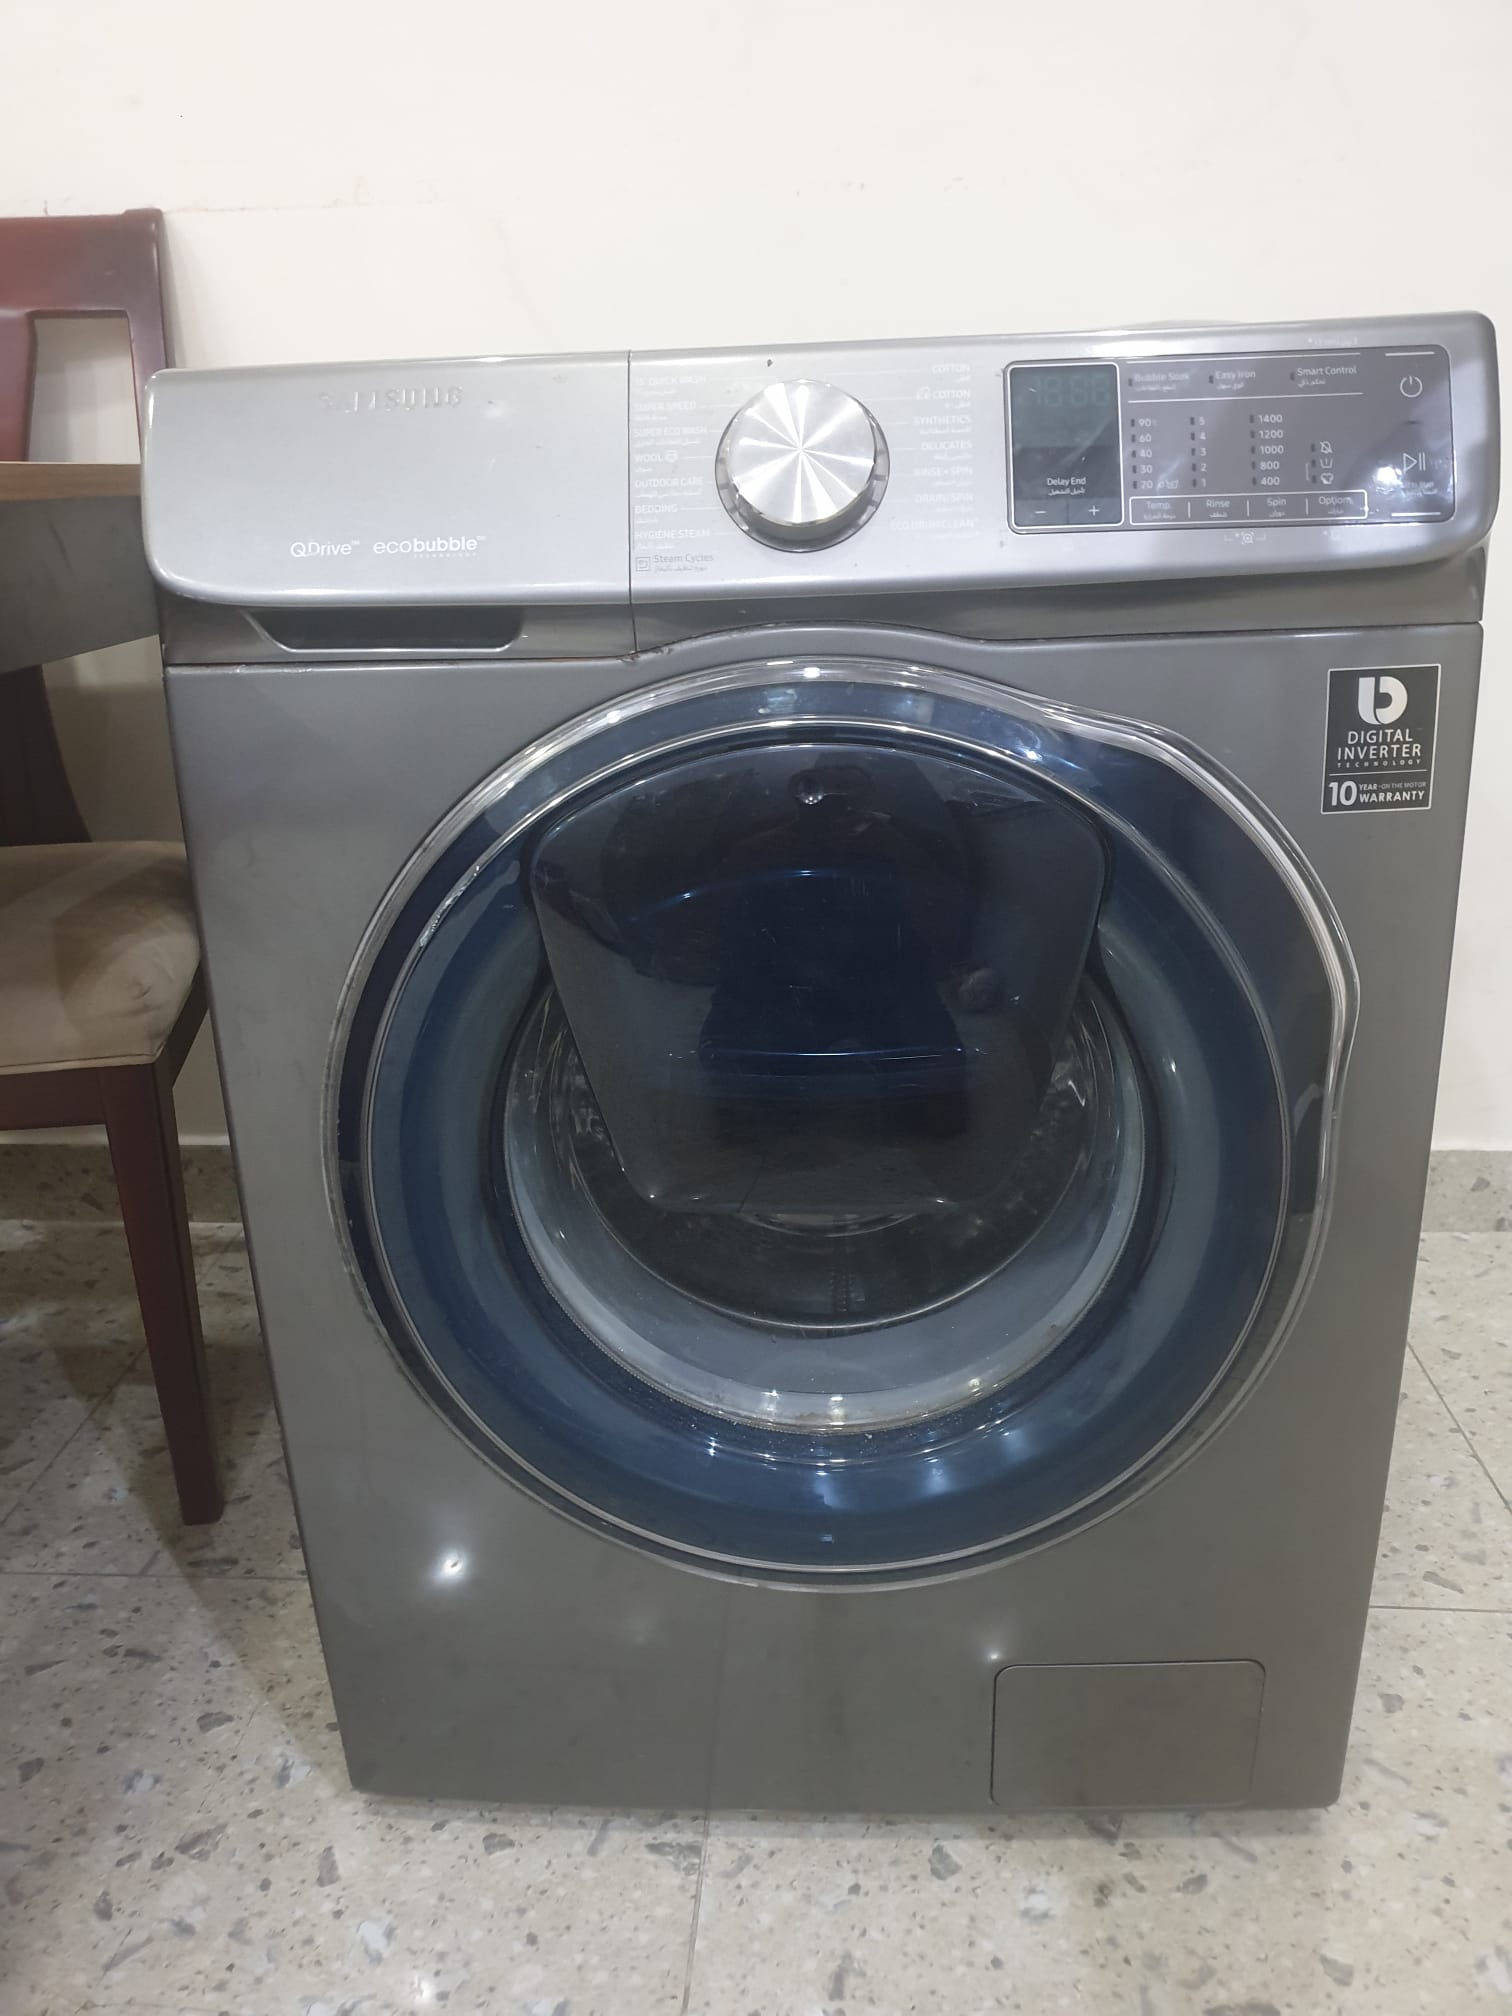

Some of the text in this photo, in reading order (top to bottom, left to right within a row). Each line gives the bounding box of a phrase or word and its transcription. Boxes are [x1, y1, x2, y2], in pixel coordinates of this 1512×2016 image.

[1215, 370, 1256, 380] Easy Iron
[1296, 365, 1357, 377] Smart Control
[933, 389, 970, 401] COTTON
[1199, 417, 1206, 426] 5
[1258, 414, 1283, 424] 1400
[1138, 434, 1152, 443] 60
[1199, 432, 1207, 440] 4
[1258, 429, 1284, 439] 1200
[1139, 449, 1153, 458] 40
[1199, 447, 1207, 456] 3
[1259, 445, 1284, 454] 1000
[1140, 464, 1153, 474] 30
[1200, 463, 1207, 472] 2
[1260, 460, 1280, 470] 800
[634, 477, 679, 488] OUTDOOR
[1046, 475, 1087, 488] Delay End
[1260, 476, 1280, 486] 400
[1206, 499, 1230, 508] Rinse
[1266, 497, 1287, 508] Spin
[635, 503, 678, 514] BEDDING
[653, 552, 714, 564] Steam Cycles
[1347, 728, 1414, 745] DIGITAL
[1337, 743, 1422, 761] INVERTER
[1337, 758, 1422, 769] TECHNOLOGY
[1328, 780, 1358, 806] 10
[1359, 783, 1378, 791] YEAR
[1359, 790, 1425, 804] WARRANTY
